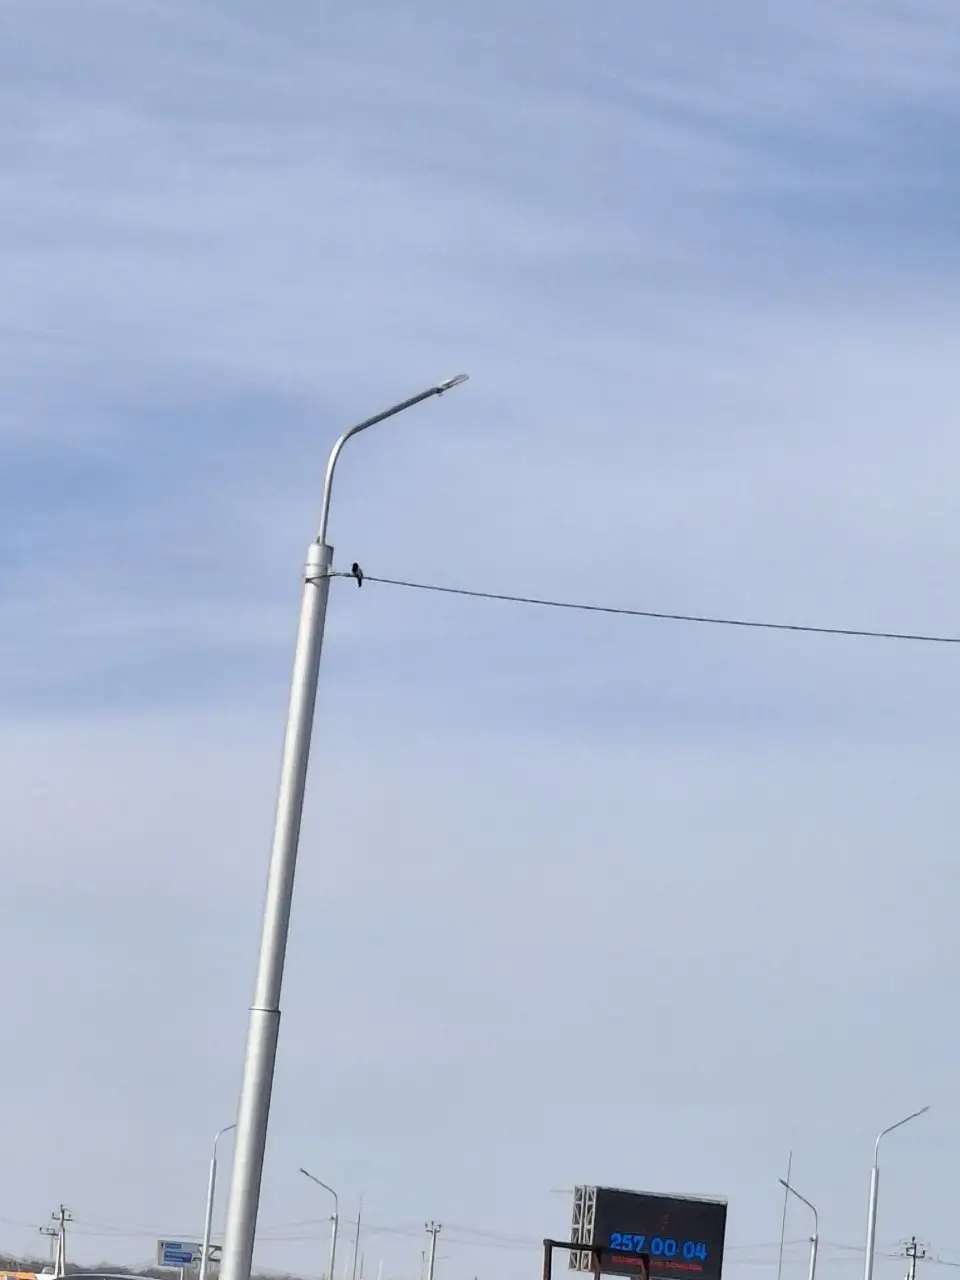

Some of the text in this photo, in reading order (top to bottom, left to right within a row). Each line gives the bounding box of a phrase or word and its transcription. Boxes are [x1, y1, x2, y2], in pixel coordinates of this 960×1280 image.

[610, 1232, 708, 1261] 257 00 04
